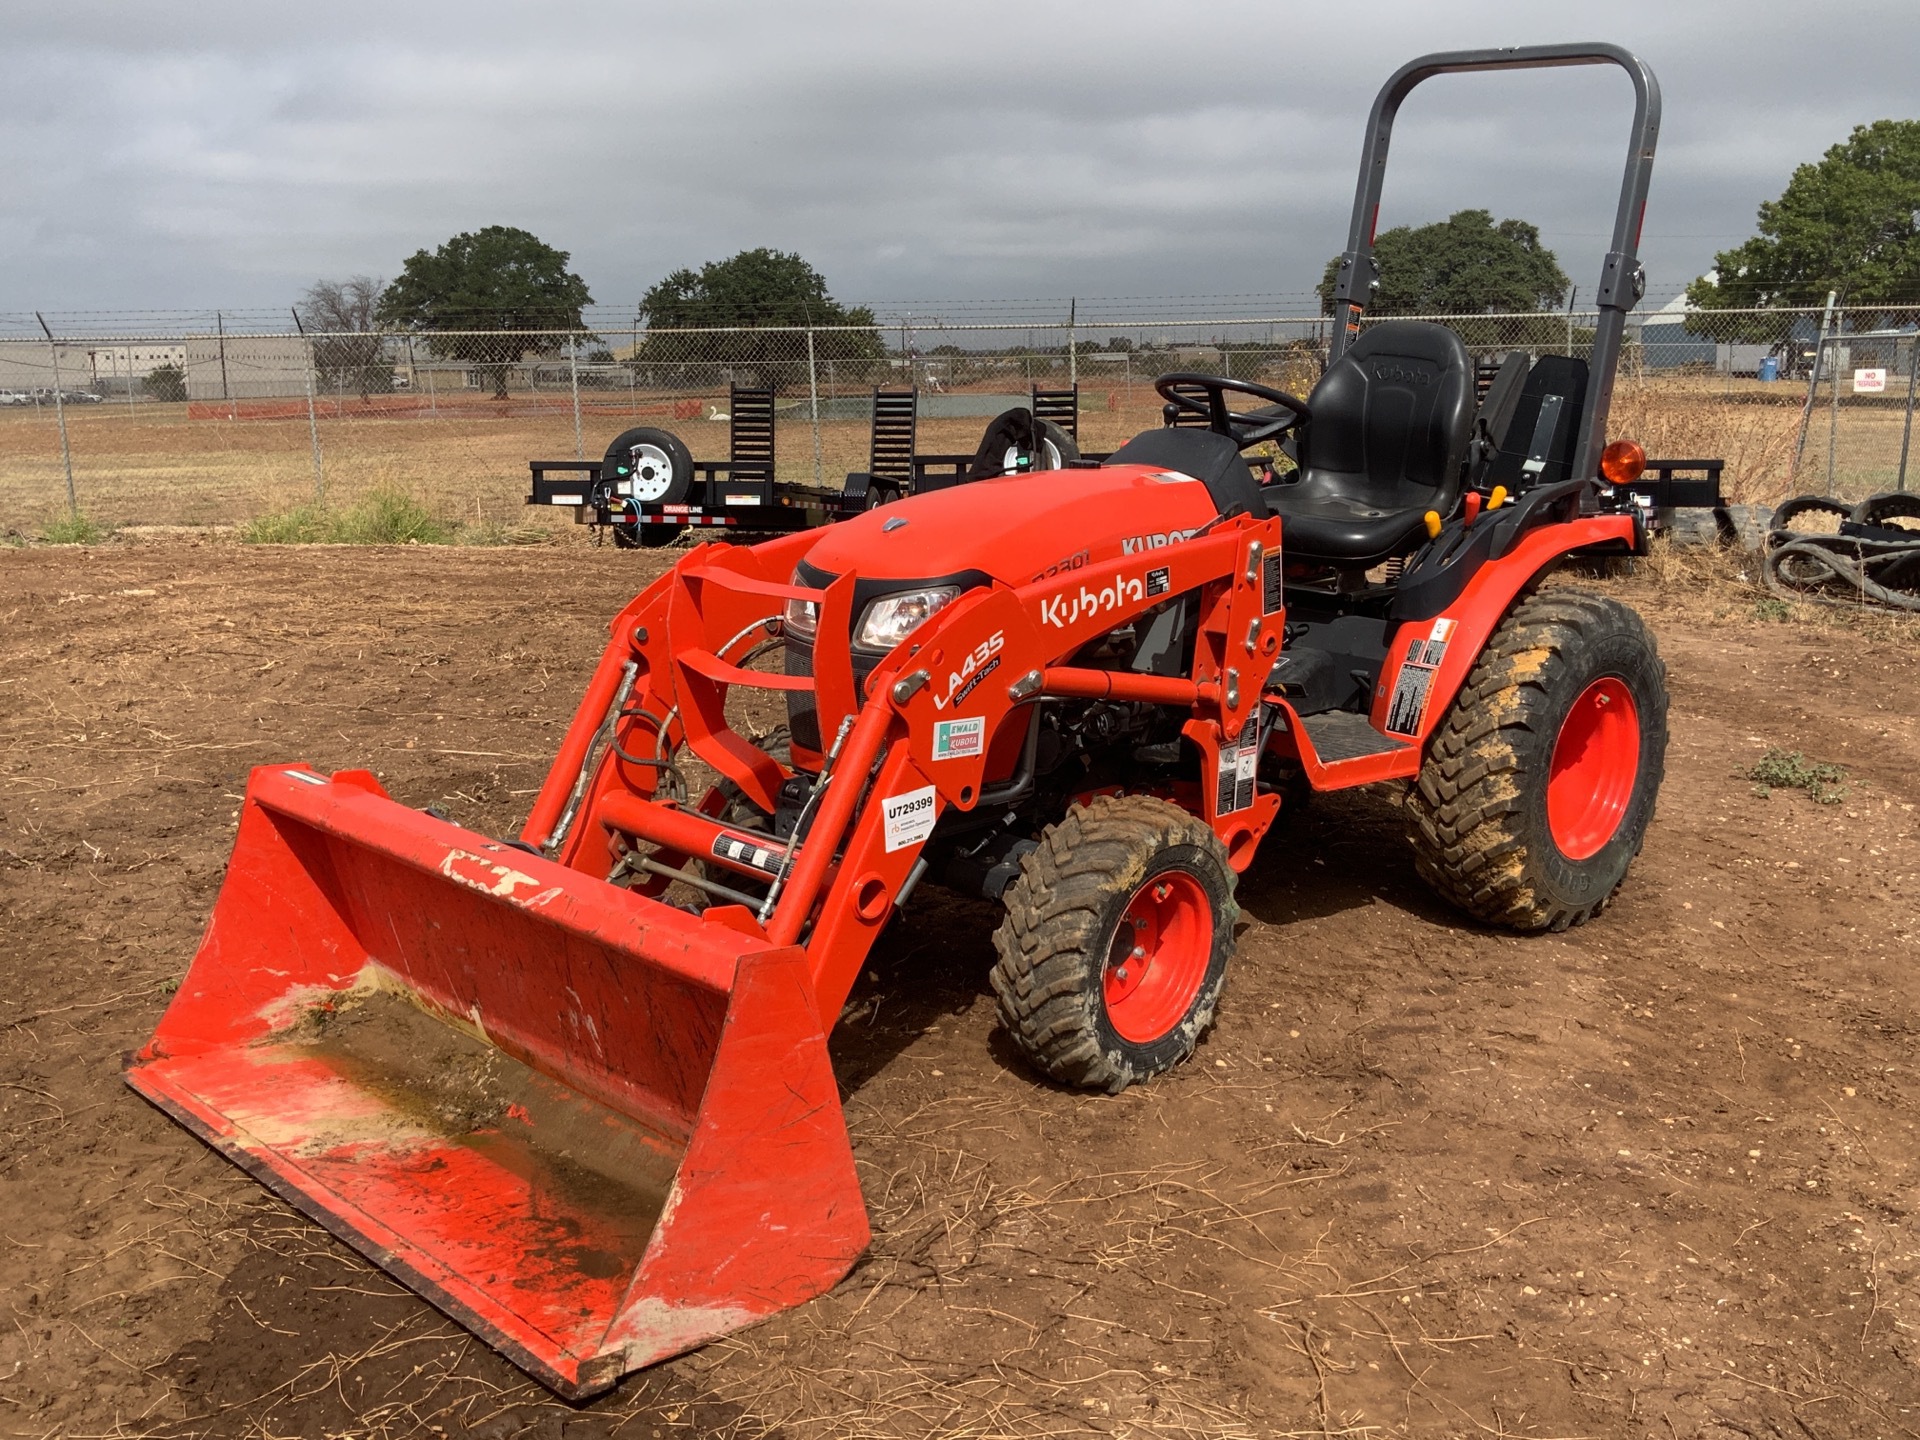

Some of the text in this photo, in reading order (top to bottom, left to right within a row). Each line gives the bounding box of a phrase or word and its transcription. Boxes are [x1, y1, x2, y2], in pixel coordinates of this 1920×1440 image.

[1370, 362, 1430, 386] Kubota
[1121, 527, 1201, 556] KUBOT
[1041, 574, 1142, 628] Kubota
[933, 629, 1004, 711] LA435
[955, 658, 999, 705] Swift-Tach
[951, 722, 978, 734] EWALD
[950, 736, 977, 749] KUBOTA
[889, 796, 933, 819] U729399
